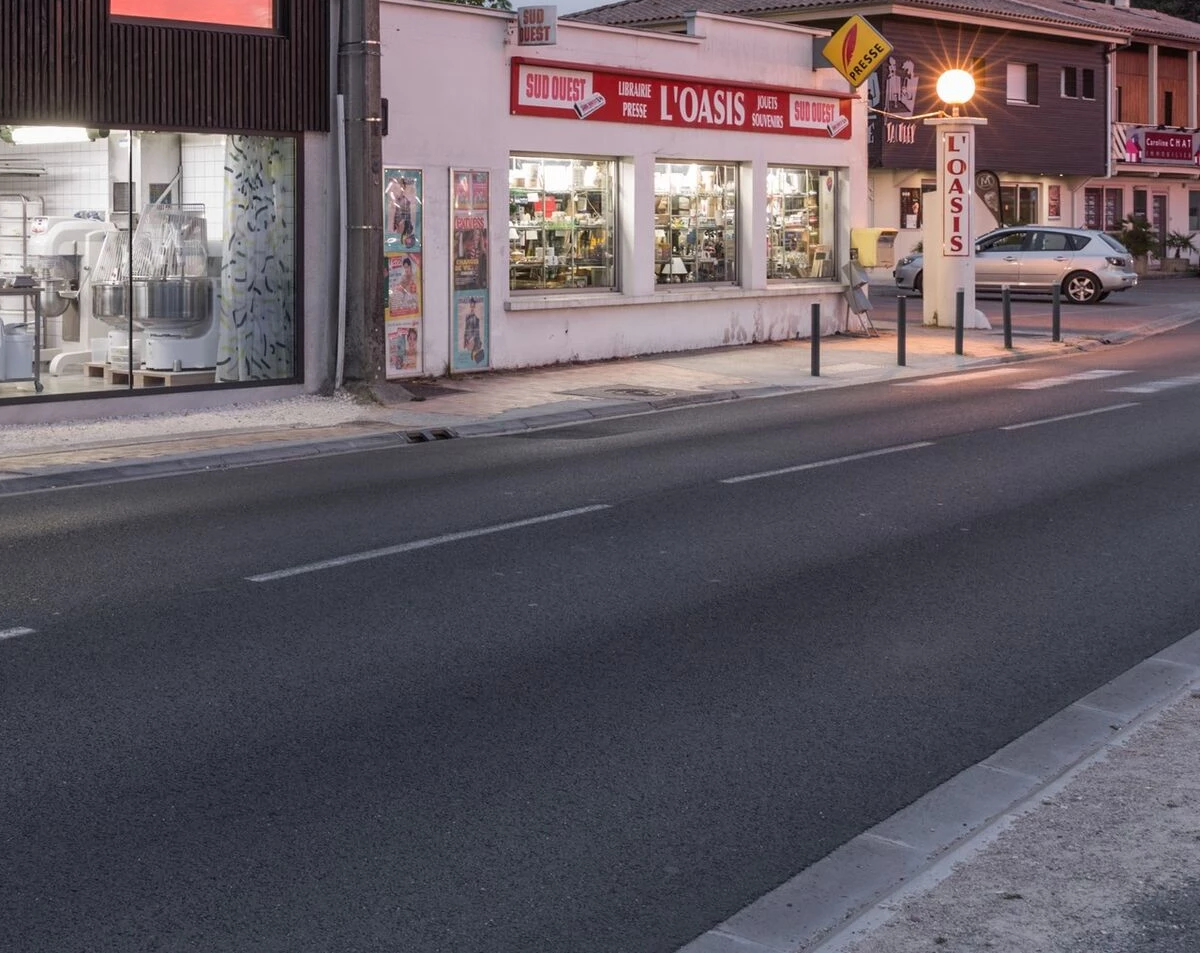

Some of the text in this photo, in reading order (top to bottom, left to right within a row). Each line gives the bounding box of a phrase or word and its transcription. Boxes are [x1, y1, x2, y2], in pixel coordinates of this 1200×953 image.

[523, 8, 544, 25] SUD
[849, 43, 884, 81] PRESSE
[526, 73, 586, 102] SUD OUEST
[618, 80, 652, 98] LIBRAIRIE
[622, 102, 648, 118] PRESSE
[660, 84, 746, 126] L'OASIS
[757, 95, 778, 110] JOUETS
[794, 100, 835, 123] SUD OUEST
[752, 112, 784, 129] SOUVENIRS
[1146, 138, 1192, 148] Caroline CHAT
[947, 136, 967, 252] L'OASIS
